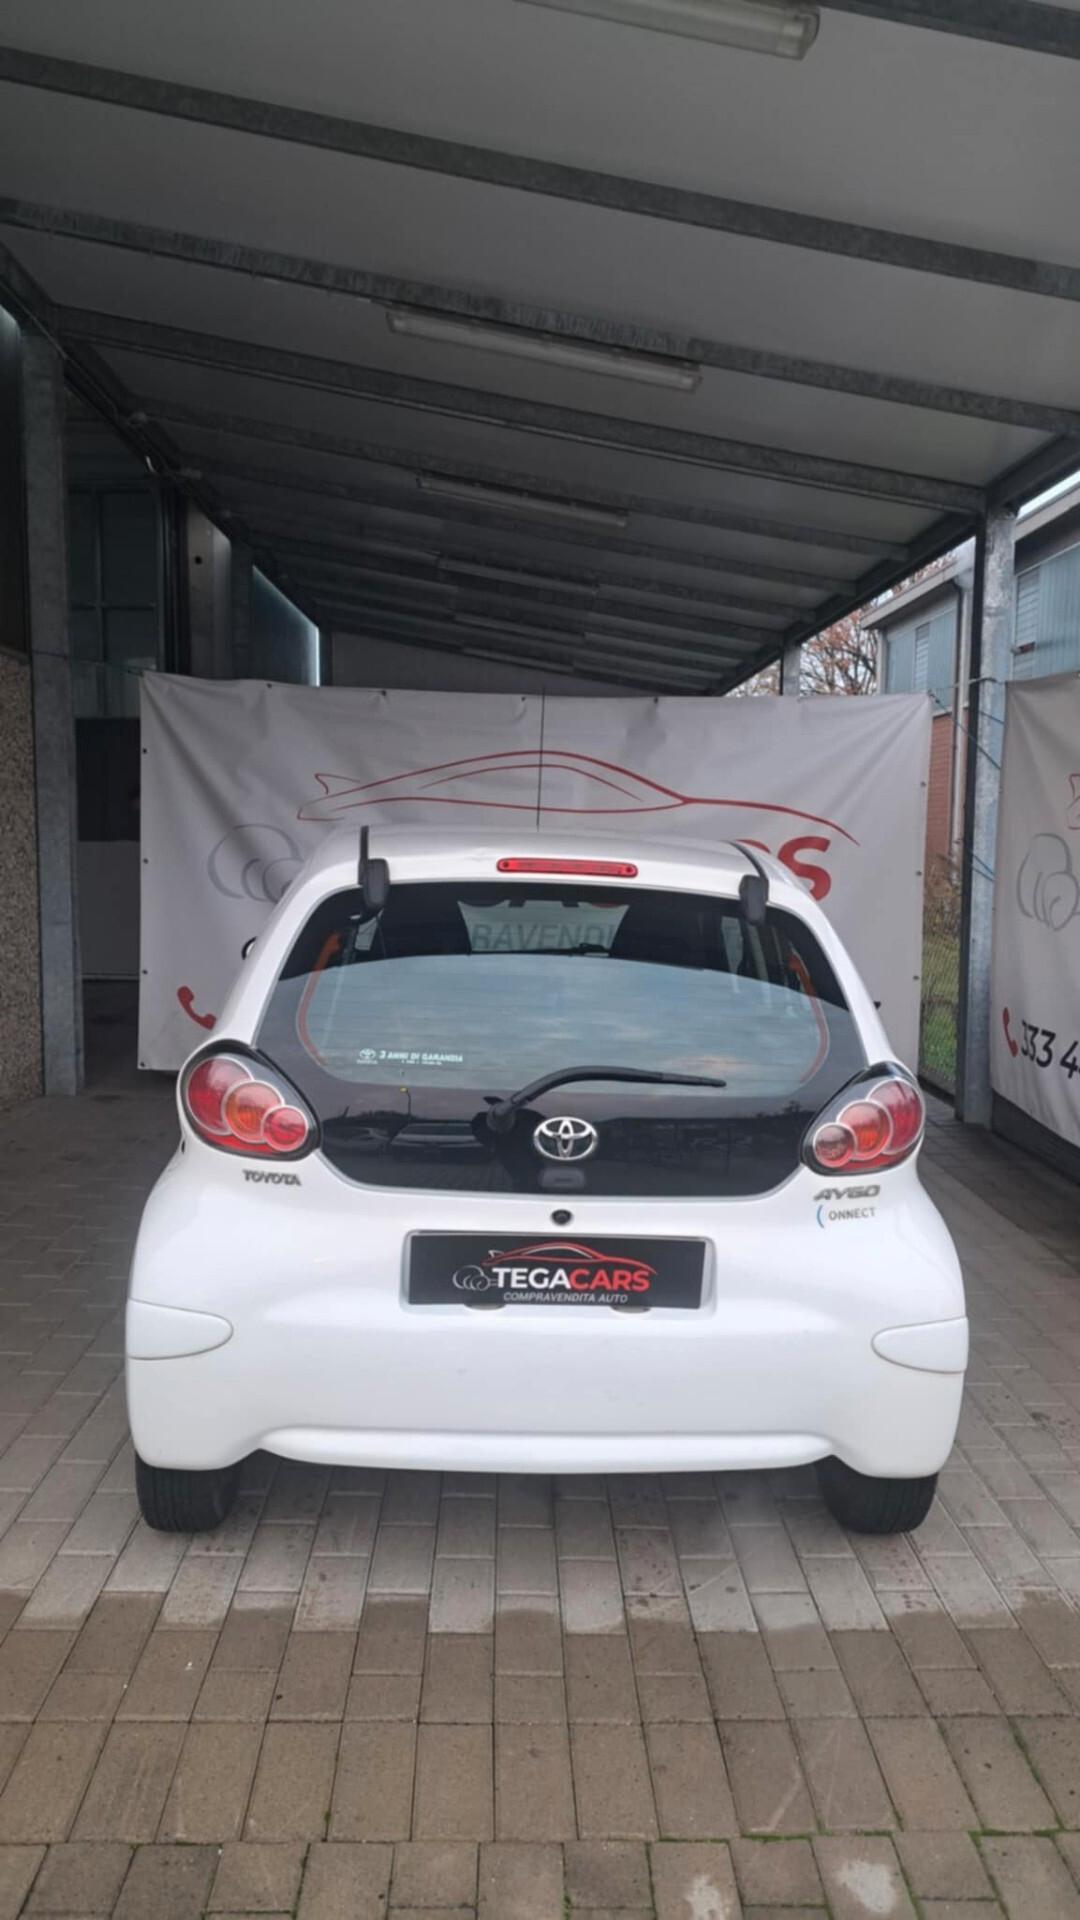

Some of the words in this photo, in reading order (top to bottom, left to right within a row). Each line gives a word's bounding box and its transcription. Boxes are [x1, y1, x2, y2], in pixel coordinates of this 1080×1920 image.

[1021, 1019, 1056, 1068] 333
[1060, 1040, 1080, 1079] 4
[242, 1169, 302, 1186] TOYOTA
[813, 1185, 881, 1201] AYGO
[492, 1267, 649, 1292] TEGACARS
[503, 1291, 595, 1302] COMPRAVENDITA
[598, 1293, 628, 1303] AUTO
